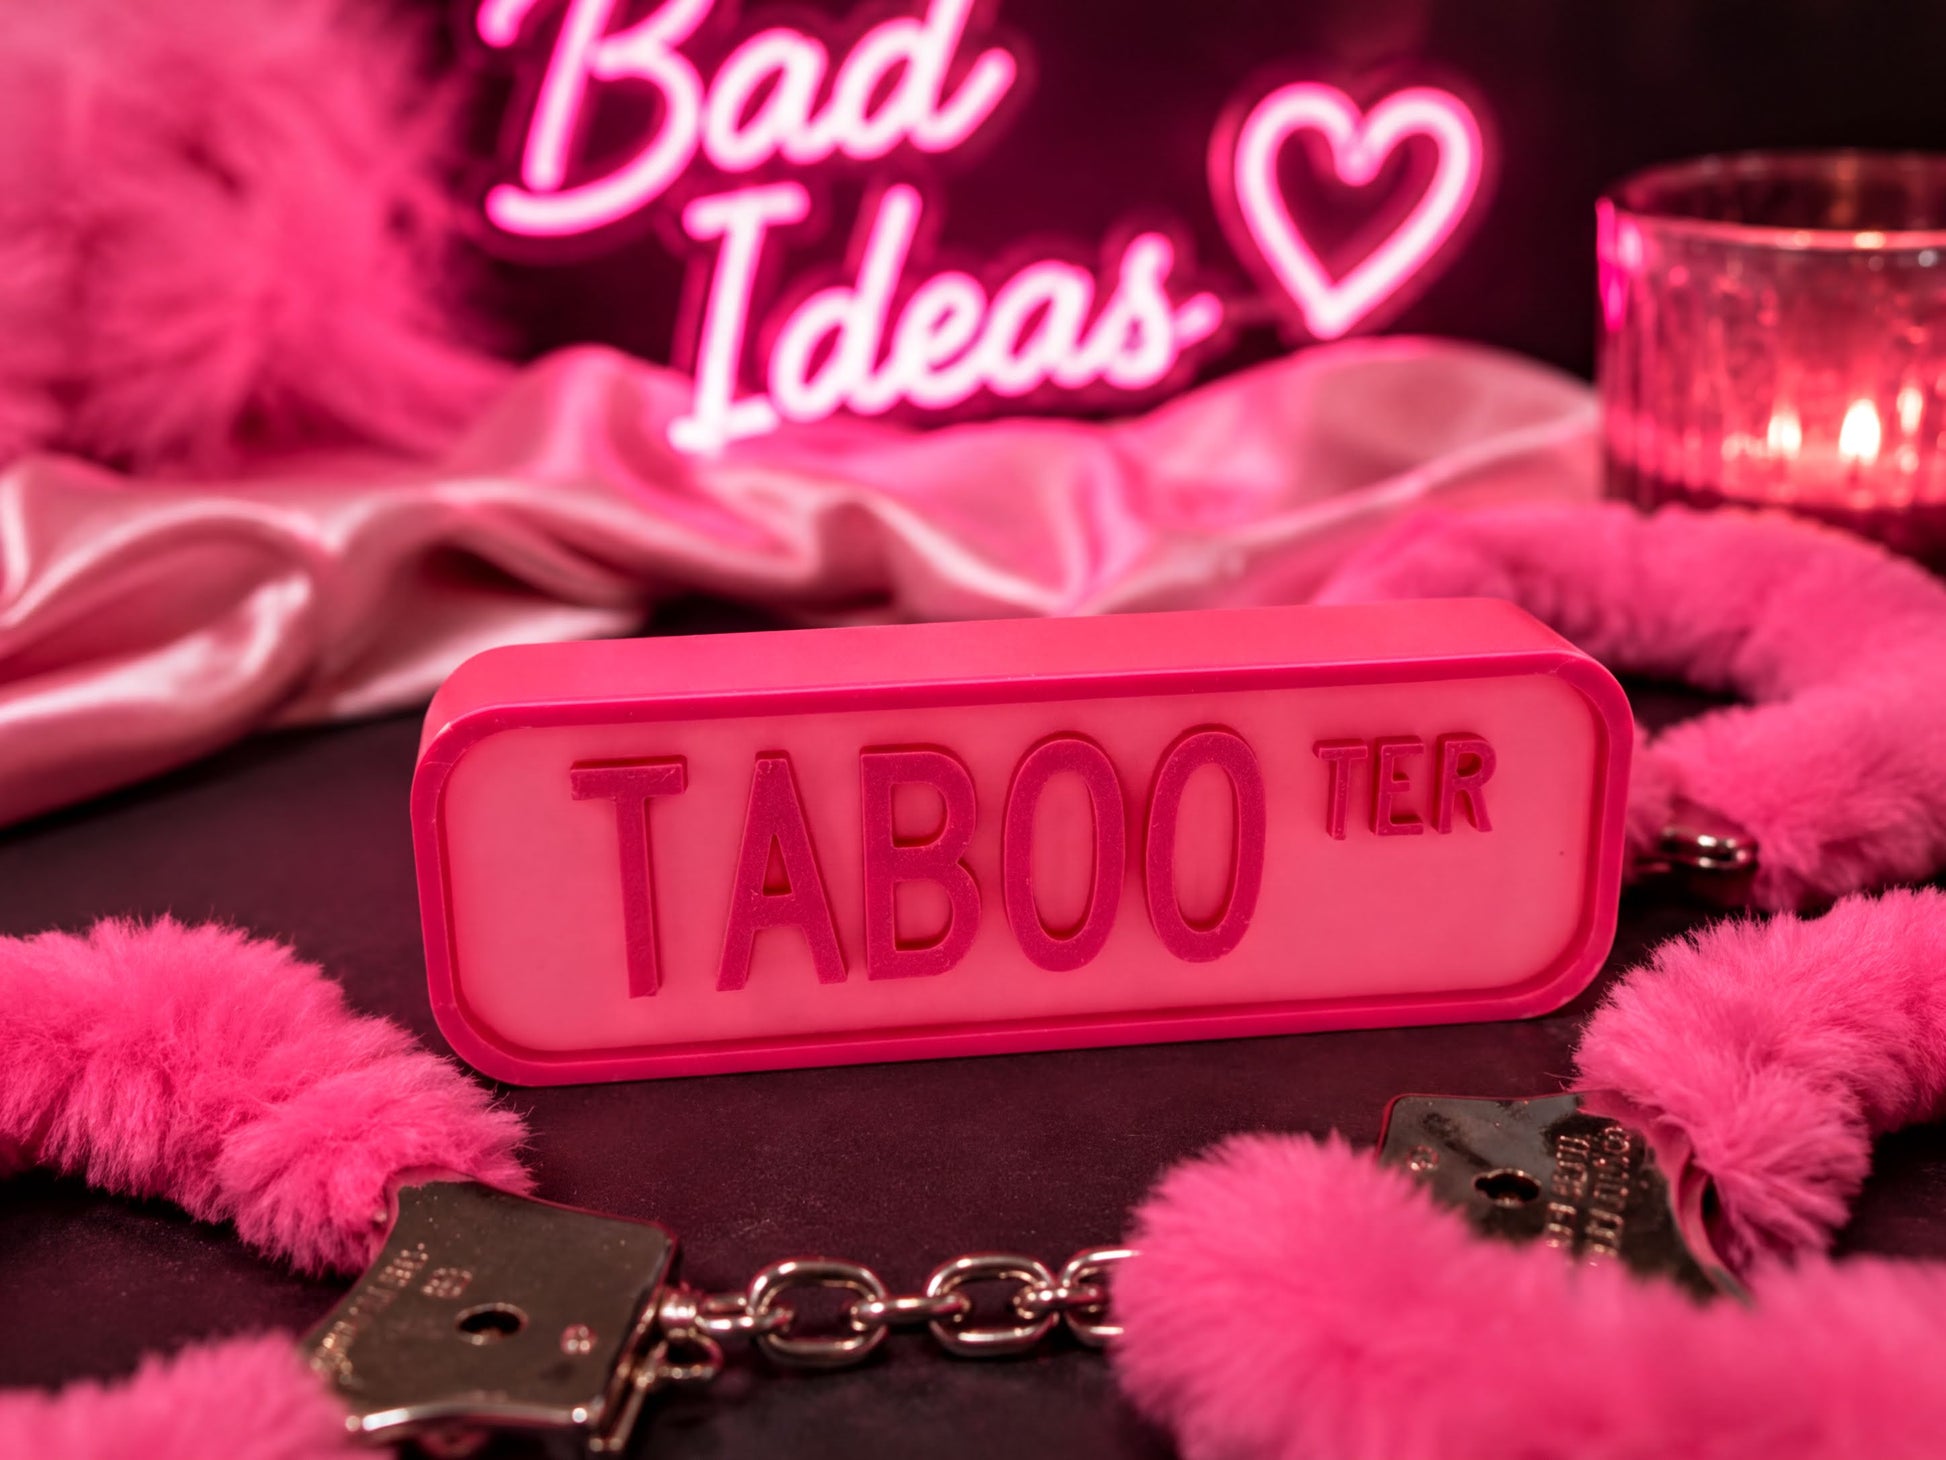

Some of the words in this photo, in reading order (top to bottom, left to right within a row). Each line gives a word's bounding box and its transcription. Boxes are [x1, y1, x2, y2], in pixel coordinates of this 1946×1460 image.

[477, 0, 1017, 237] Bad
[668, 182, 1222, 455] Ideas
[570, 723, 1267, 999] TABOO
[1313, 732, 1497, 841] TER
